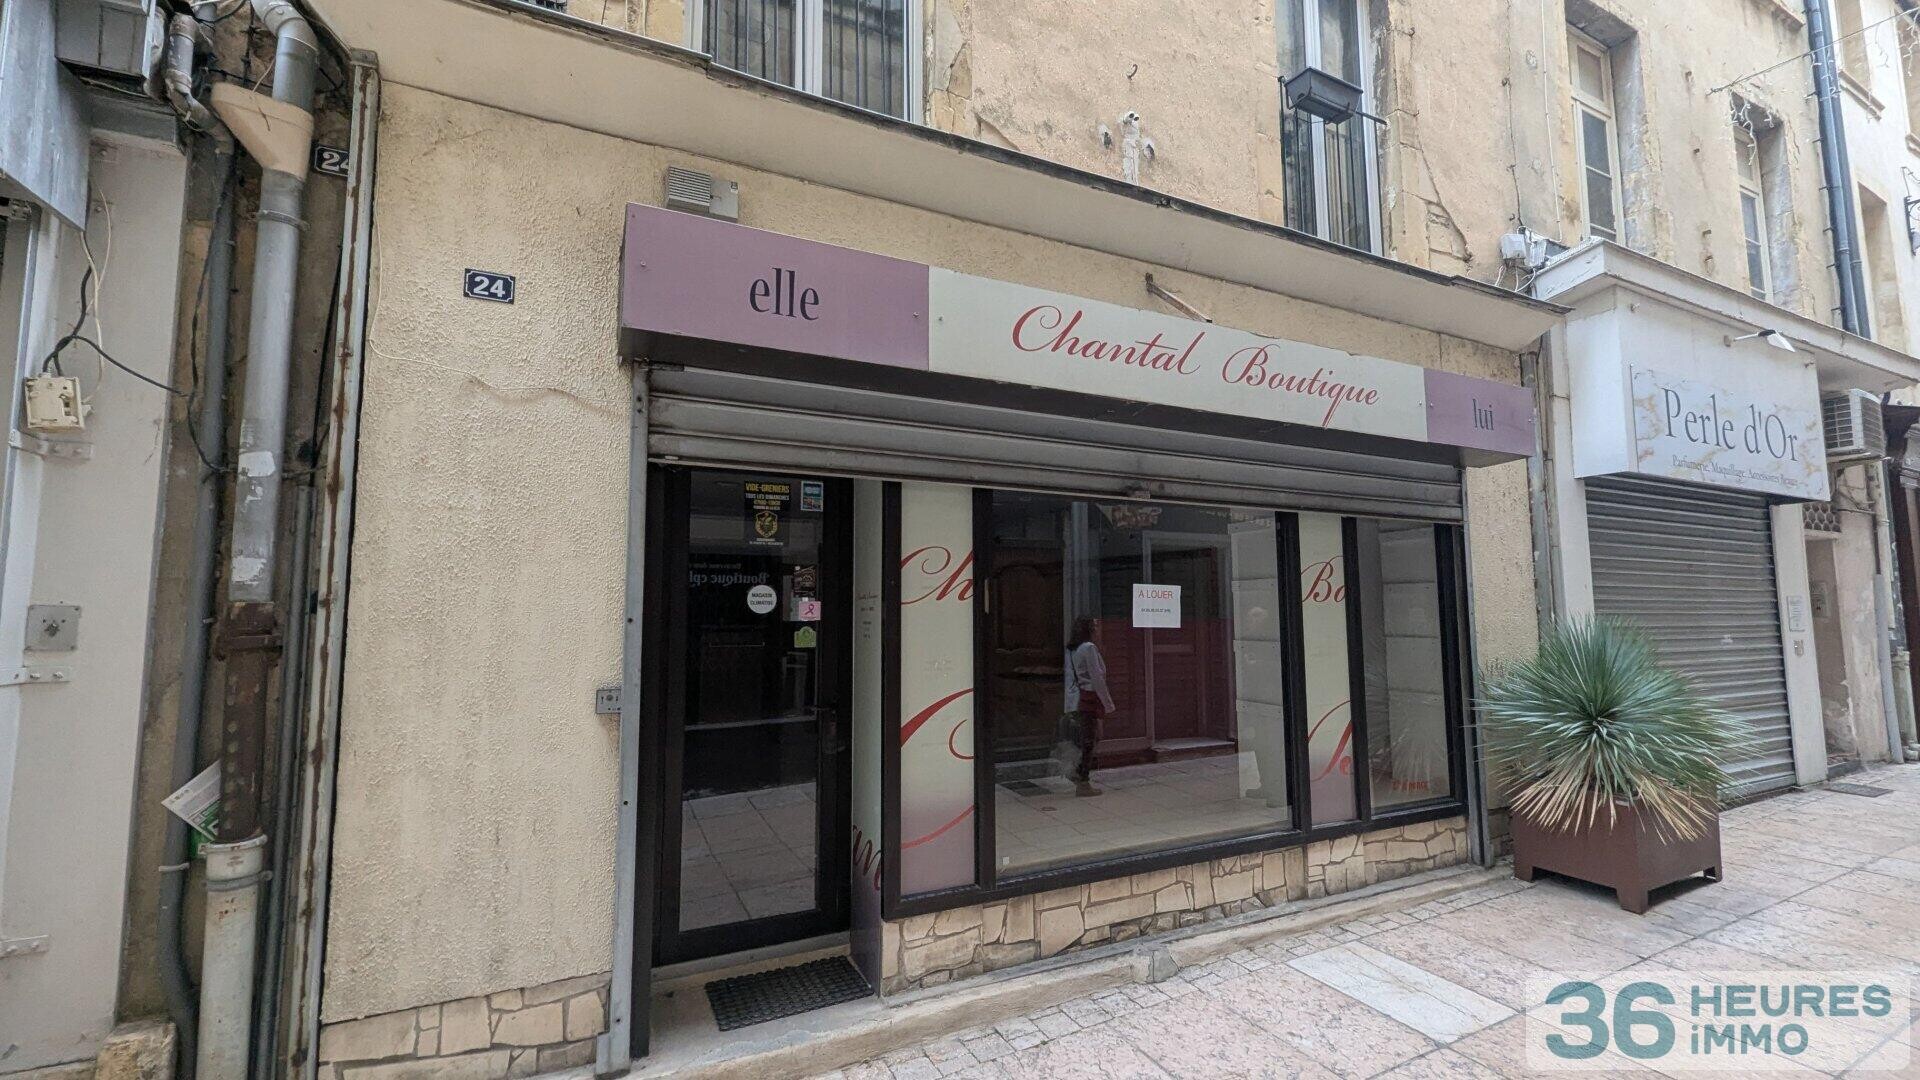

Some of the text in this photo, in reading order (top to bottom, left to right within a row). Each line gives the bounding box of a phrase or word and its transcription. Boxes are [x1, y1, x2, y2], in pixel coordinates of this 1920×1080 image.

[473, 276, 506, 297] 24
[749, 267, 819, 321] elle
[1012, 305, 1380, 429] Chantal Boutique
[1472, 398, 1494, 431] lui
[1661, 387, 1798, 462] Perle d'Or
[1138, 590, 1173, 600] A LOUER
